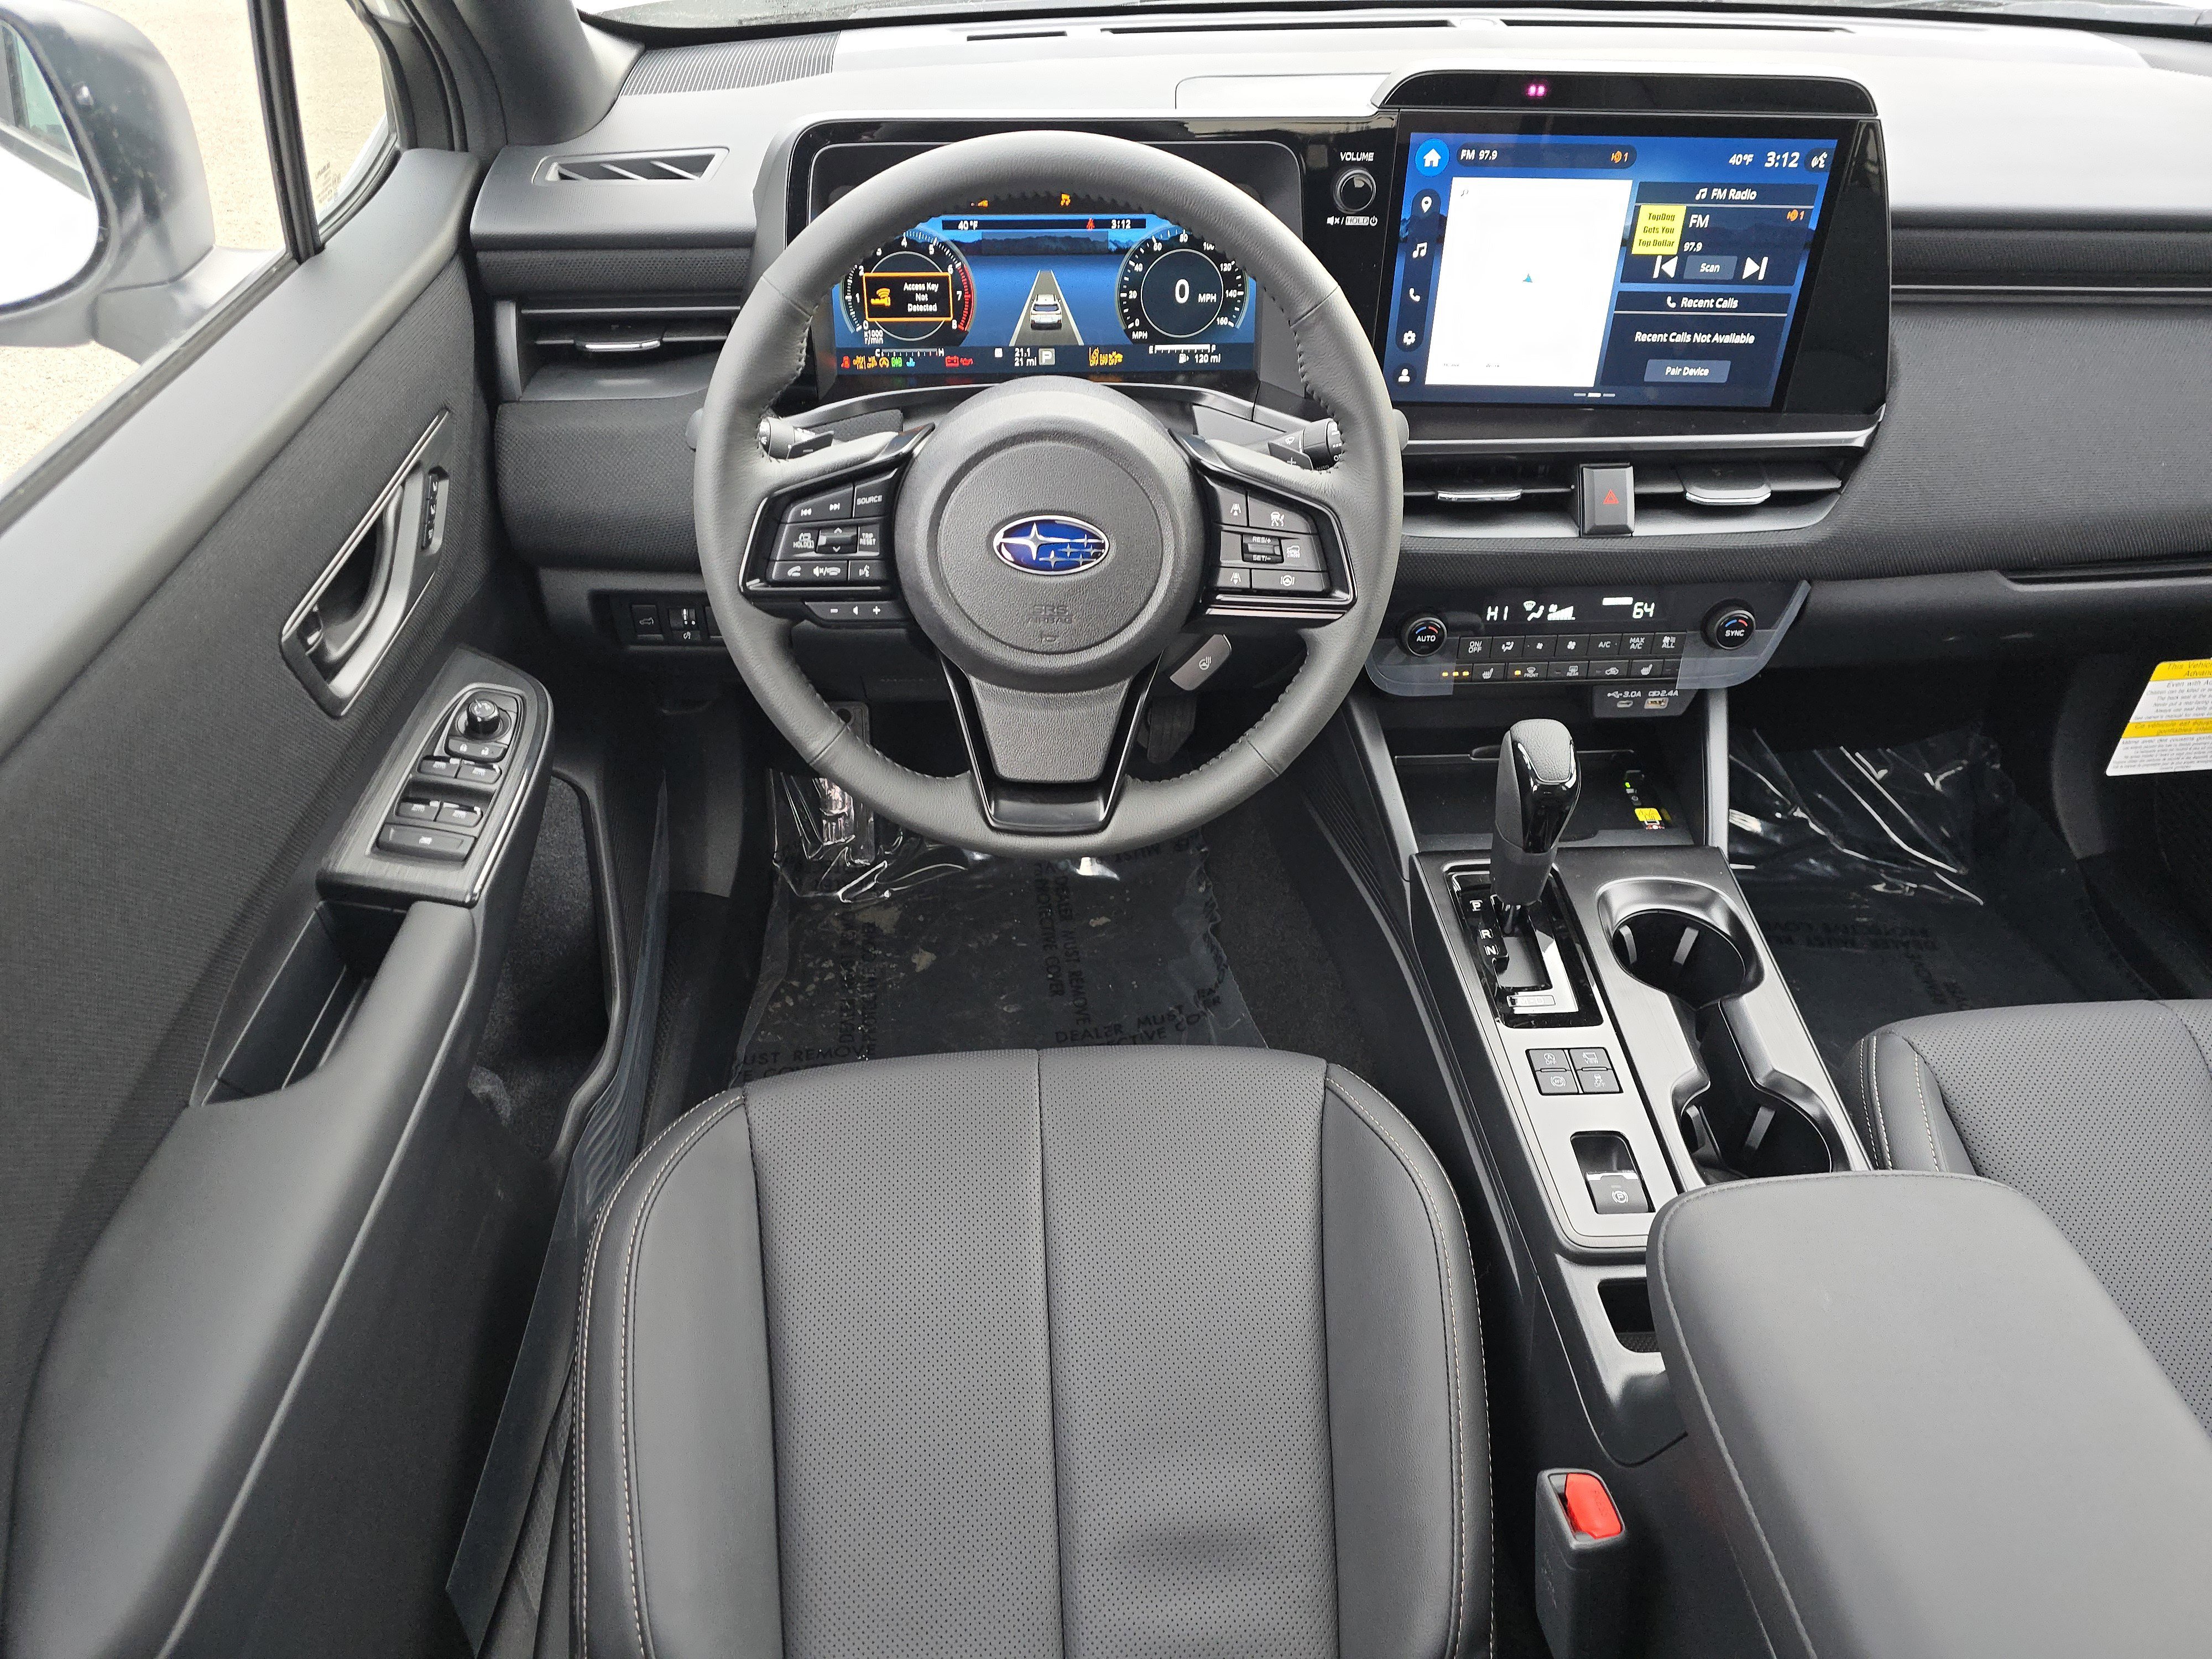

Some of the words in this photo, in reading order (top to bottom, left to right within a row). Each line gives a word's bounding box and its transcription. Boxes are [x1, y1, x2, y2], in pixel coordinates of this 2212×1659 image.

[1340, 152, 1374, 161] VOLUME
[1460, 149, 1475, 160] FM
[1479, 150, 1498, 160] 97.9
[1729, 154, 1754, 165] 40°F
[1765, 152, 1799, 168] 3:12
[1710, 189, 1726, 200] FM
[1729, 189, 1757, 200] Radio
[1111, 220, 1131, 229] 3:12
[1689, 215, 1710, 228] FM
[901, 237, 907, 248] 4
[1180, 234, 1188, 242] 80
[929, 244, 935, 255] 5
[1154, 243, 1162, 251] 60
[1683, 242, 1703, 252] 97.9
[859, 265, 864, 276] 2
[947, 264, 953, 274] 6
[1134, 263, 1143, 272] 40
[1220, 263, 1232, 272] 120
[1700, 263, 1720, 273] Scan
[904, 282, 926, 291] Access
[927, 282, 939, 292] Key
[1175, 279, 1189, 304] 0
[855, 293, 860, 302] 1
[916, 293, 928, 301] Not
[957, 291, 962, 301] 7
[1129, 290, 1137, 299] 20
[1198, 294, 1217, 302] MPH
[1225, 289, 1237, 298] 140
[907, 304, 937, 312] Detected
[1681, 297, 1714, 308] Recent
[1715, 297, 1738, 309] Calls
[863, 320, 868, 330] 0
[1635, 331, 1668, 342] Recent
[1669, 332, 1692, 342] Calls
[1693, 332, 1711, 343] Not
[1712, 332, 1755, 343] Available
[938, 348, 945, 357] H
[1015, 347, 1031, 357] 21.1
[1014, 357, 1024, 366] 21
[1026, 357, 1037, 366] mi
[1042, 351, 1052, 364] P
[1194, 353, 1208, 363] 120
[1210, 353, 1221, 363] mi
[1665, 366, 1682, 375] Pair
[1682, 367, 1709, 376] Device
[857, 495, 883, 505] SOURCE
[1486, 606, 1509, 621] HI
[1632, 602, 1655, 619] 64
[1472, 901, 1481, 911] P
[1481, 929, 1492, 939] R
[1486, 946, 1498, 956] N
[1055, 1022, 1124, 1044] DEALER
[1137, 1004, 1184, 1028] MUST
[793, 1044, 877, 1062] REMOVE
